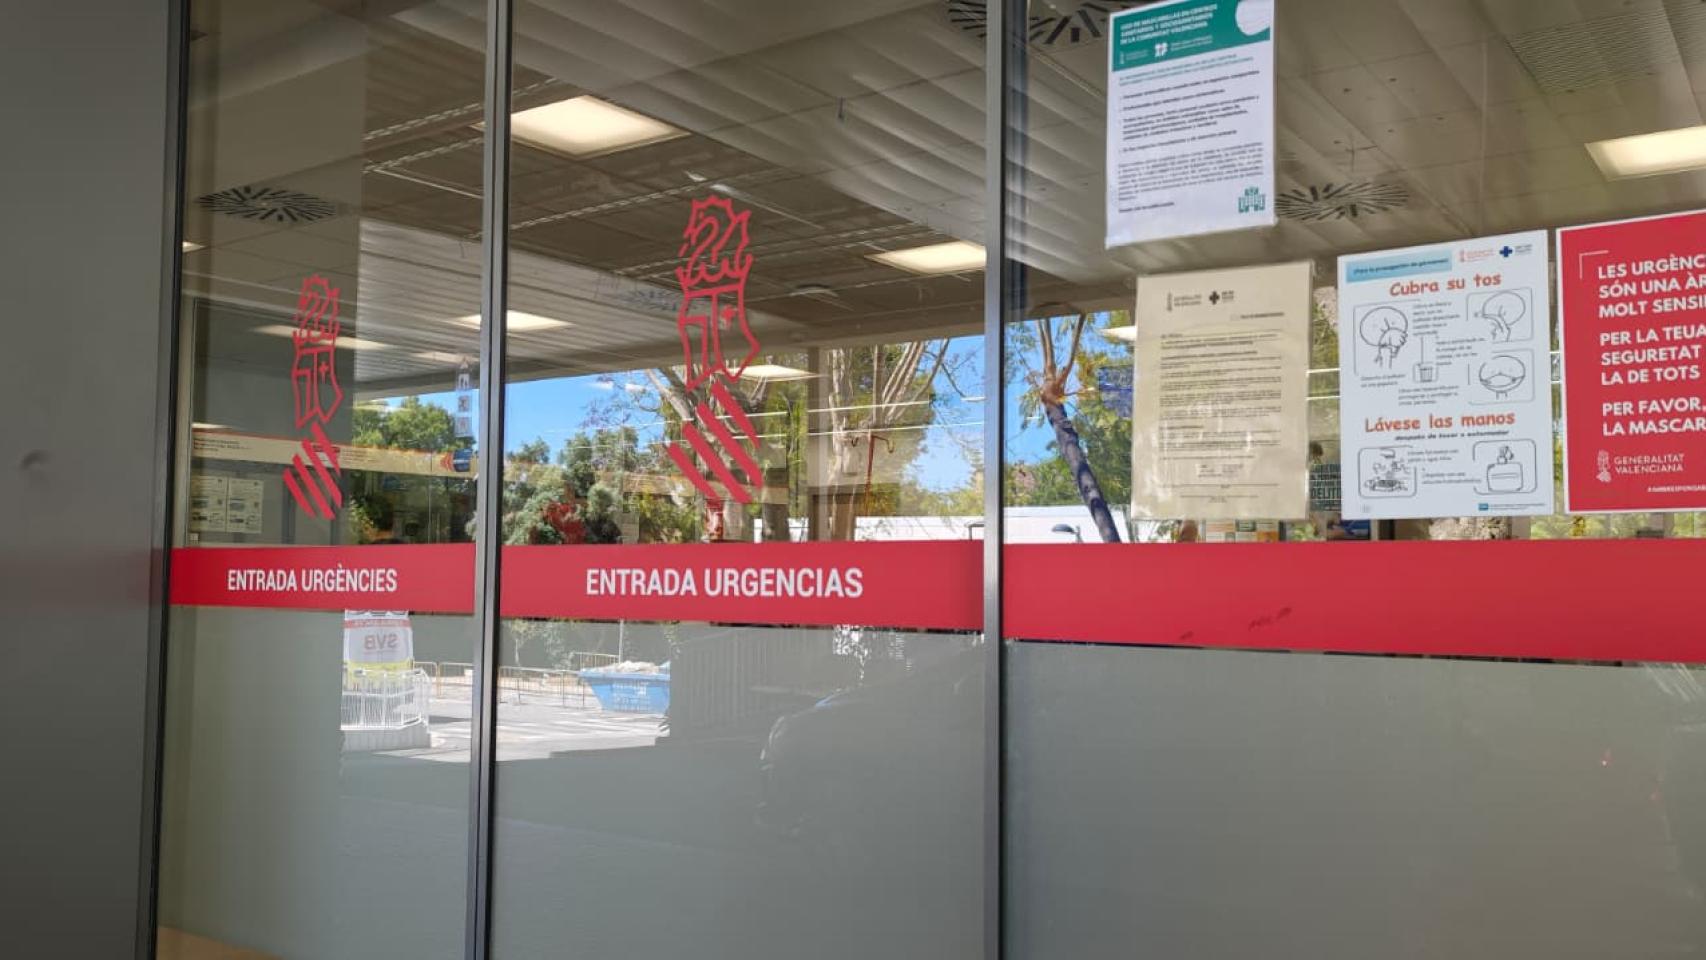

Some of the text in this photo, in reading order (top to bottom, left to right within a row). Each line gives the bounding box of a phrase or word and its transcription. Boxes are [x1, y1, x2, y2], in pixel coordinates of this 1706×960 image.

[1598, 262, 1627, 280] LES
[1389, 273, 1502, 297] Cubra su tos
[1599, 279, 1637, 299] SÓN
[1641, 277, 1681, 294] UNA
[1599, 294, 1706, 319] MOLT SENSI
[1600, 324, 1706, 346] PER LA TEUA
[1601, 344, 1702, 366] SEGURETAT
[1601, 364, 1701, 386] LA DE TOTS
[1602, 401, 1634, 417] PER
[1365, 412, 1516, 433] Lávese las manos
[1602, 416, 1706, 437] LA MASCAR
[1613, 453, 1685, 465] GENERALITAT
[1614, 462, 1684, 475] VALENCIANA
[1311, 488, 1341, 499] DELIT
[227, 563, 398, 593] ENTRADA URGÈNCIES
[586, 567, 864, 598] ENTRADA URGENCIAS
